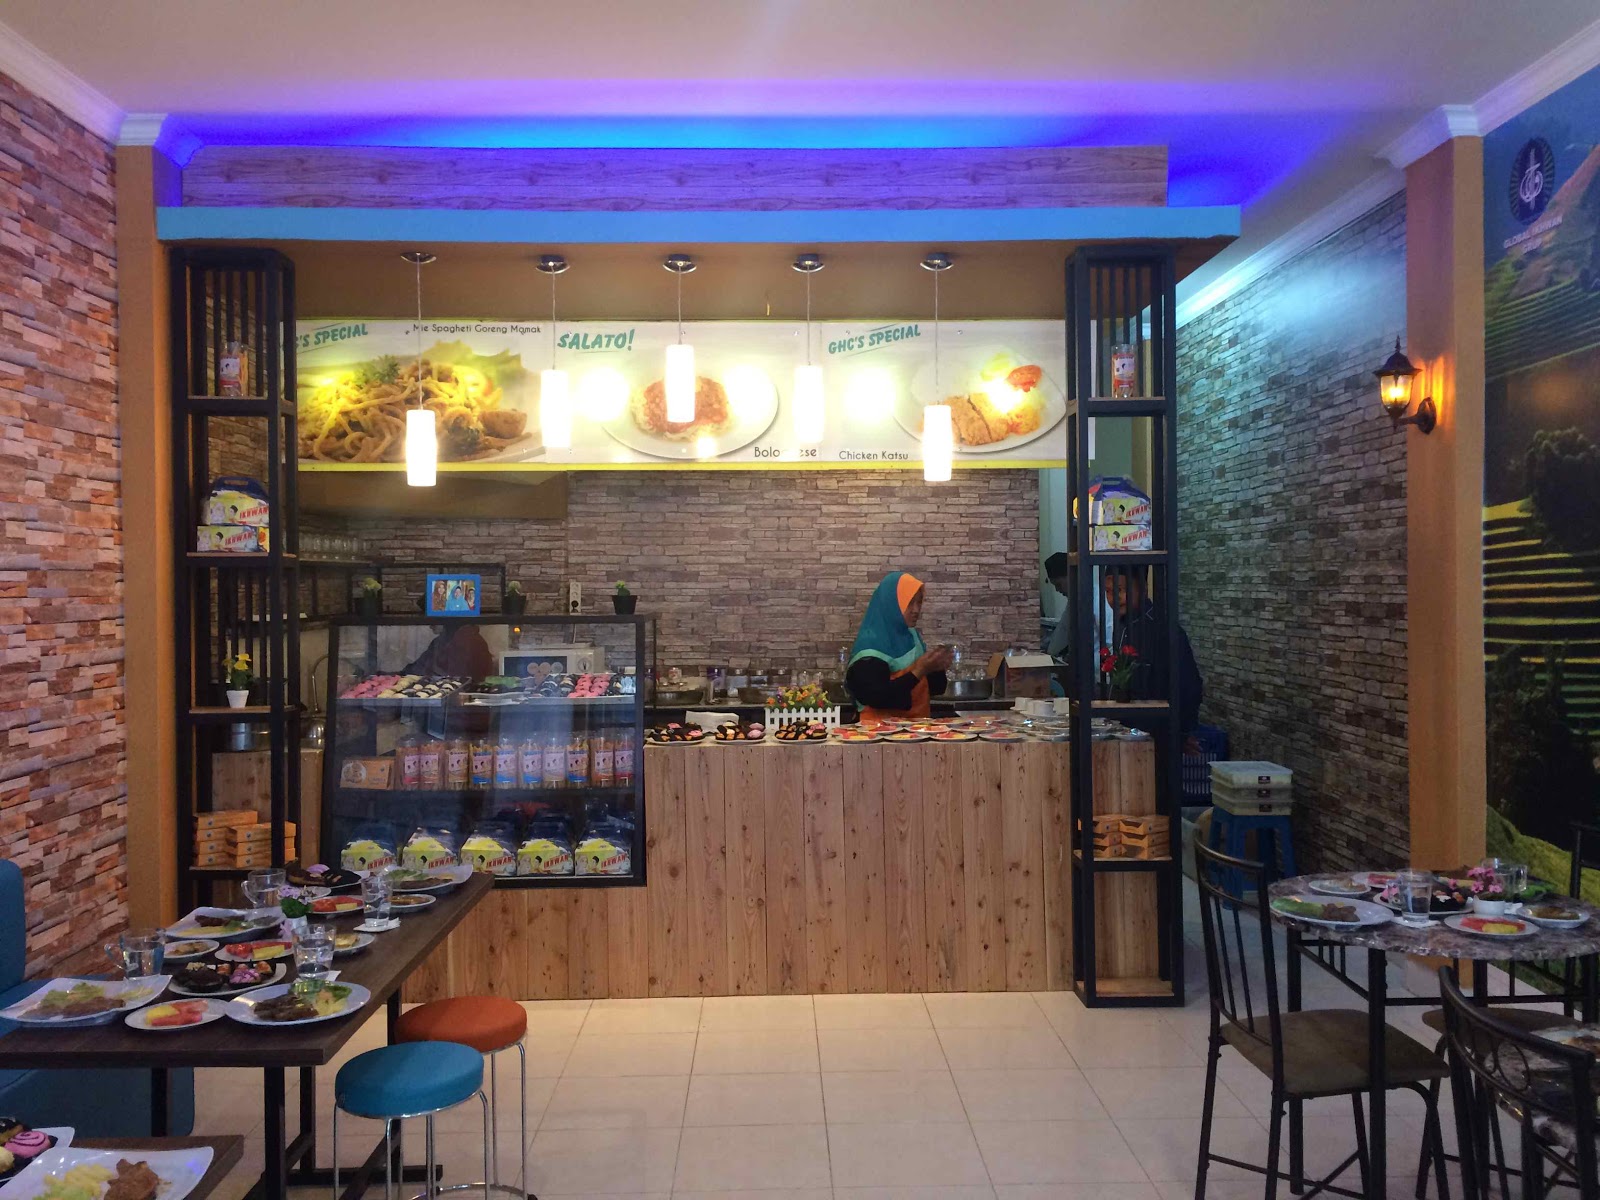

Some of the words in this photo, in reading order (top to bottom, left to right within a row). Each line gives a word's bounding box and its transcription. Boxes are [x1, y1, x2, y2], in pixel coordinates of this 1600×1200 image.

[314, 323, 368, 345] SPECIAL
[413, 323, 429, 332] Mie
[432, 323, 472, 334] Spagheti
[475, 325, 508, 334] Goreng
[557, 329, 635, 351] SALATO!
[828, 335, 865, 354] GHC'S
[869, 324, 921, 346] SPECIAL
[754, 446, 818, 458] Bolose
[839, 450, 878, 460] Chicken
[881, 450, 909, 460] Katsu
